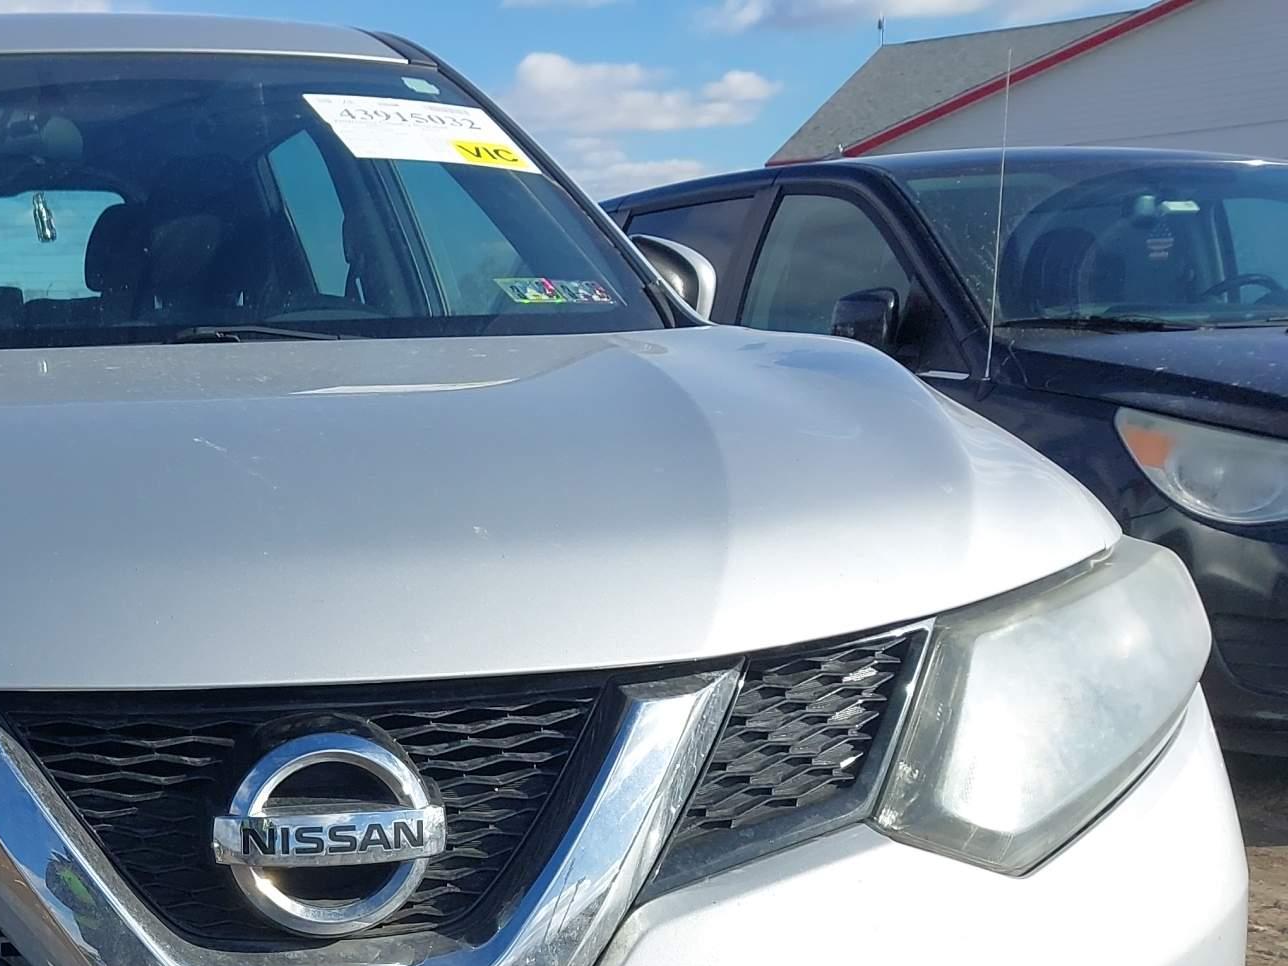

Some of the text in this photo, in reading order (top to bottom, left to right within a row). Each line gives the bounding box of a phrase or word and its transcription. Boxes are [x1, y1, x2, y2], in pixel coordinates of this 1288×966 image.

[339, 107, 482, 131] 43915032
[456, 142, 519, 162] VIC
[241, 819, 425, 856] NISSAN
